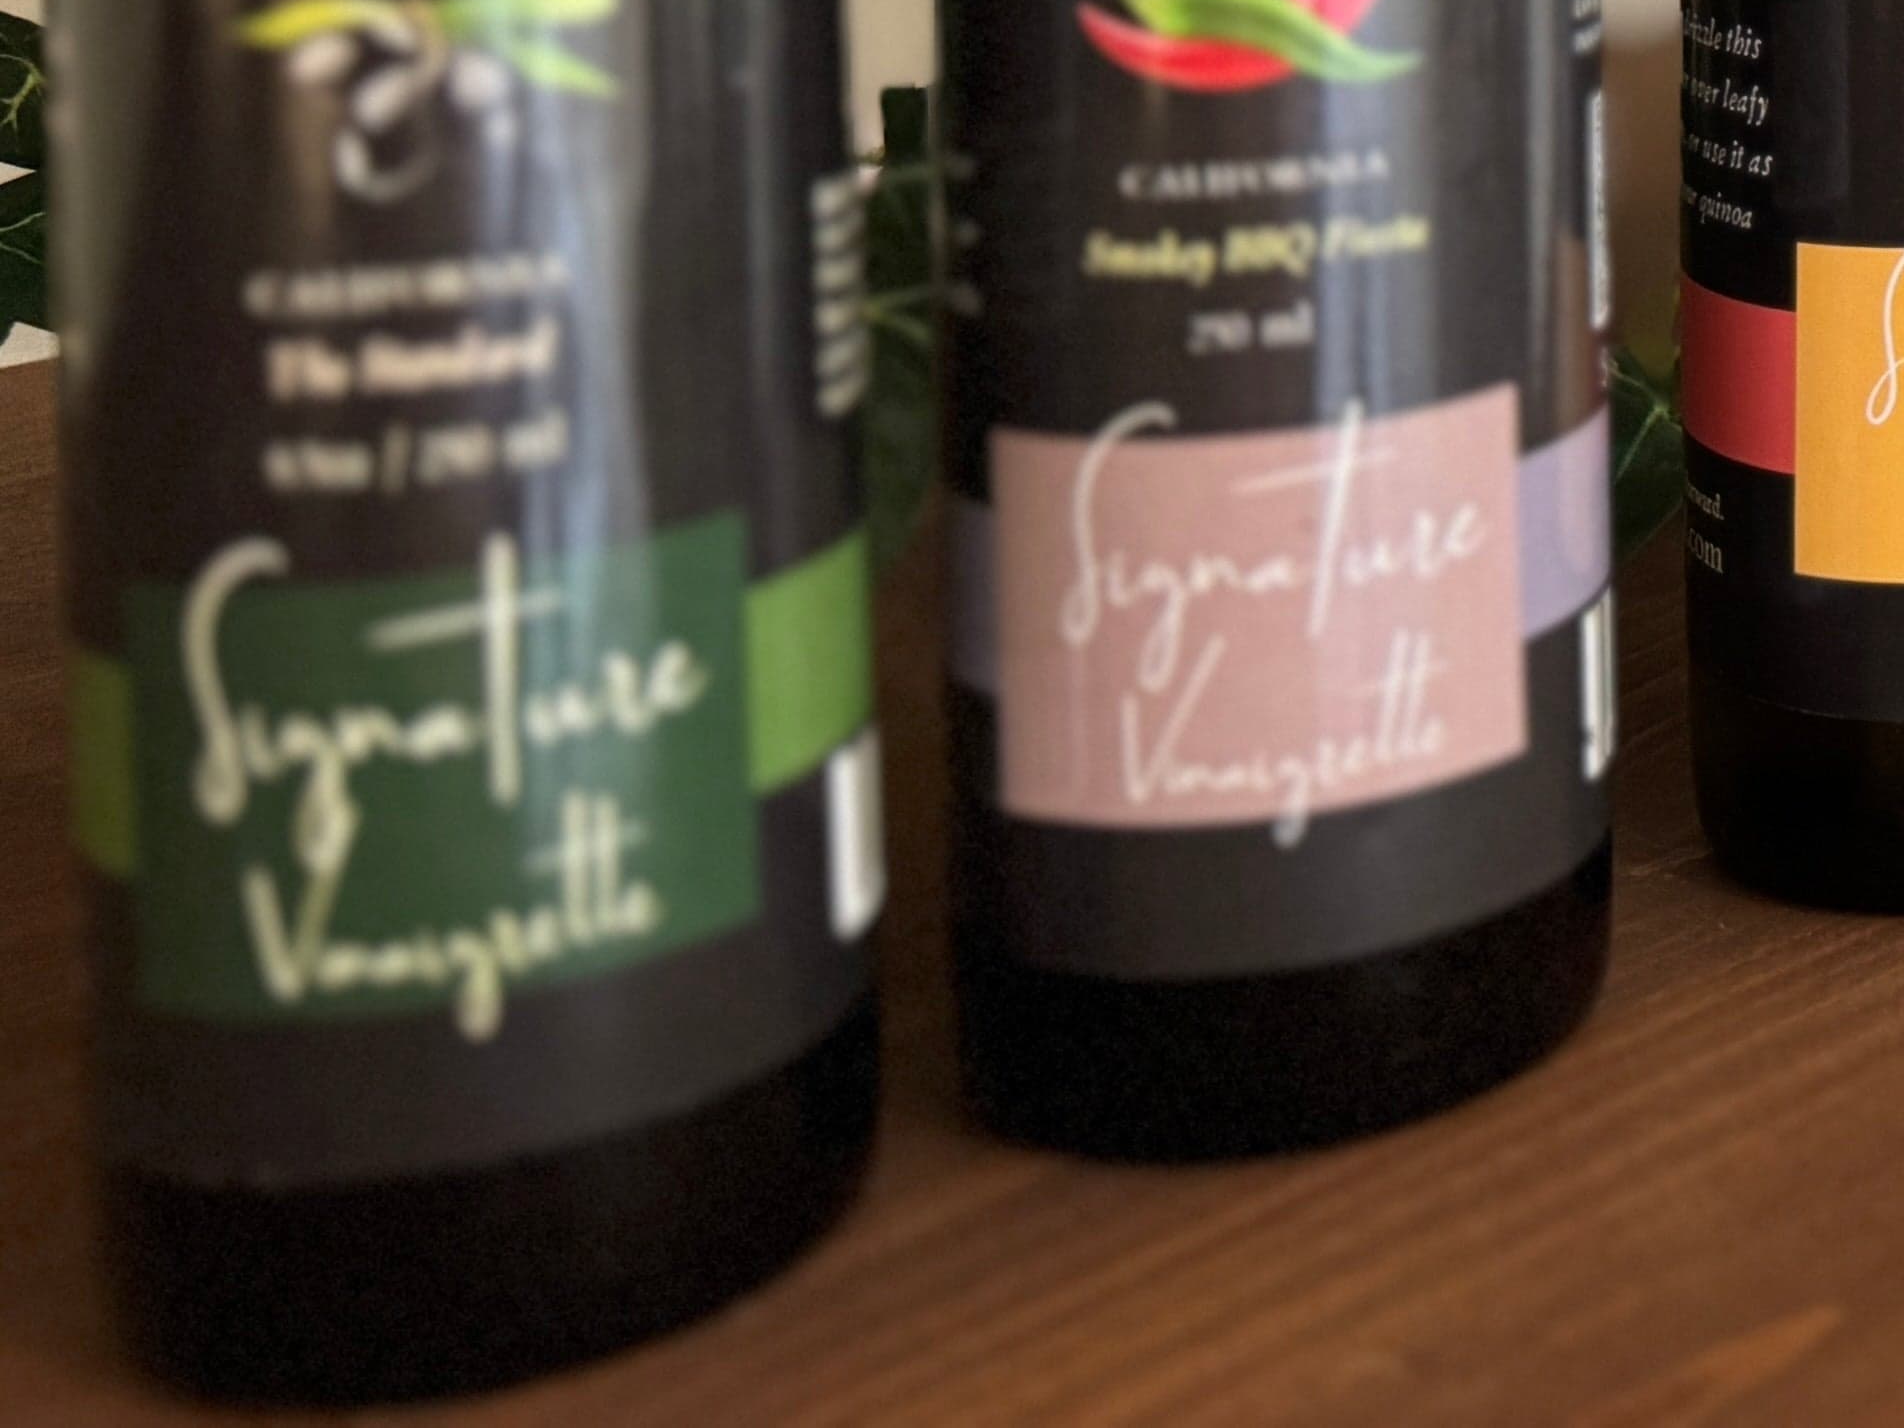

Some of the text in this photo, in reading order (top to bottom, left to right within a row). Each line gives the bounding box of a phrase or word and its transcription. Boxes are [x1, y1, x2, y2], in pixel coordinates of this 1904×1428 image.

[1726, 24, 1763, 59] this
[1722, 78, 1769, 126] leafy
[1118, 147, 1390, 200] CALIFORNIA
[1702, 140, 1727, 165] use
[1729, 140, 1744, 169] it
[1748, 153, 1774, 176] as
[1698, 191, 1753, 230] quinoa
[1061, 397, 1487, 694] Signature
[182, 533, 708, 872] Signature
[1120, 628, 1450, 849] Vinaigrette
